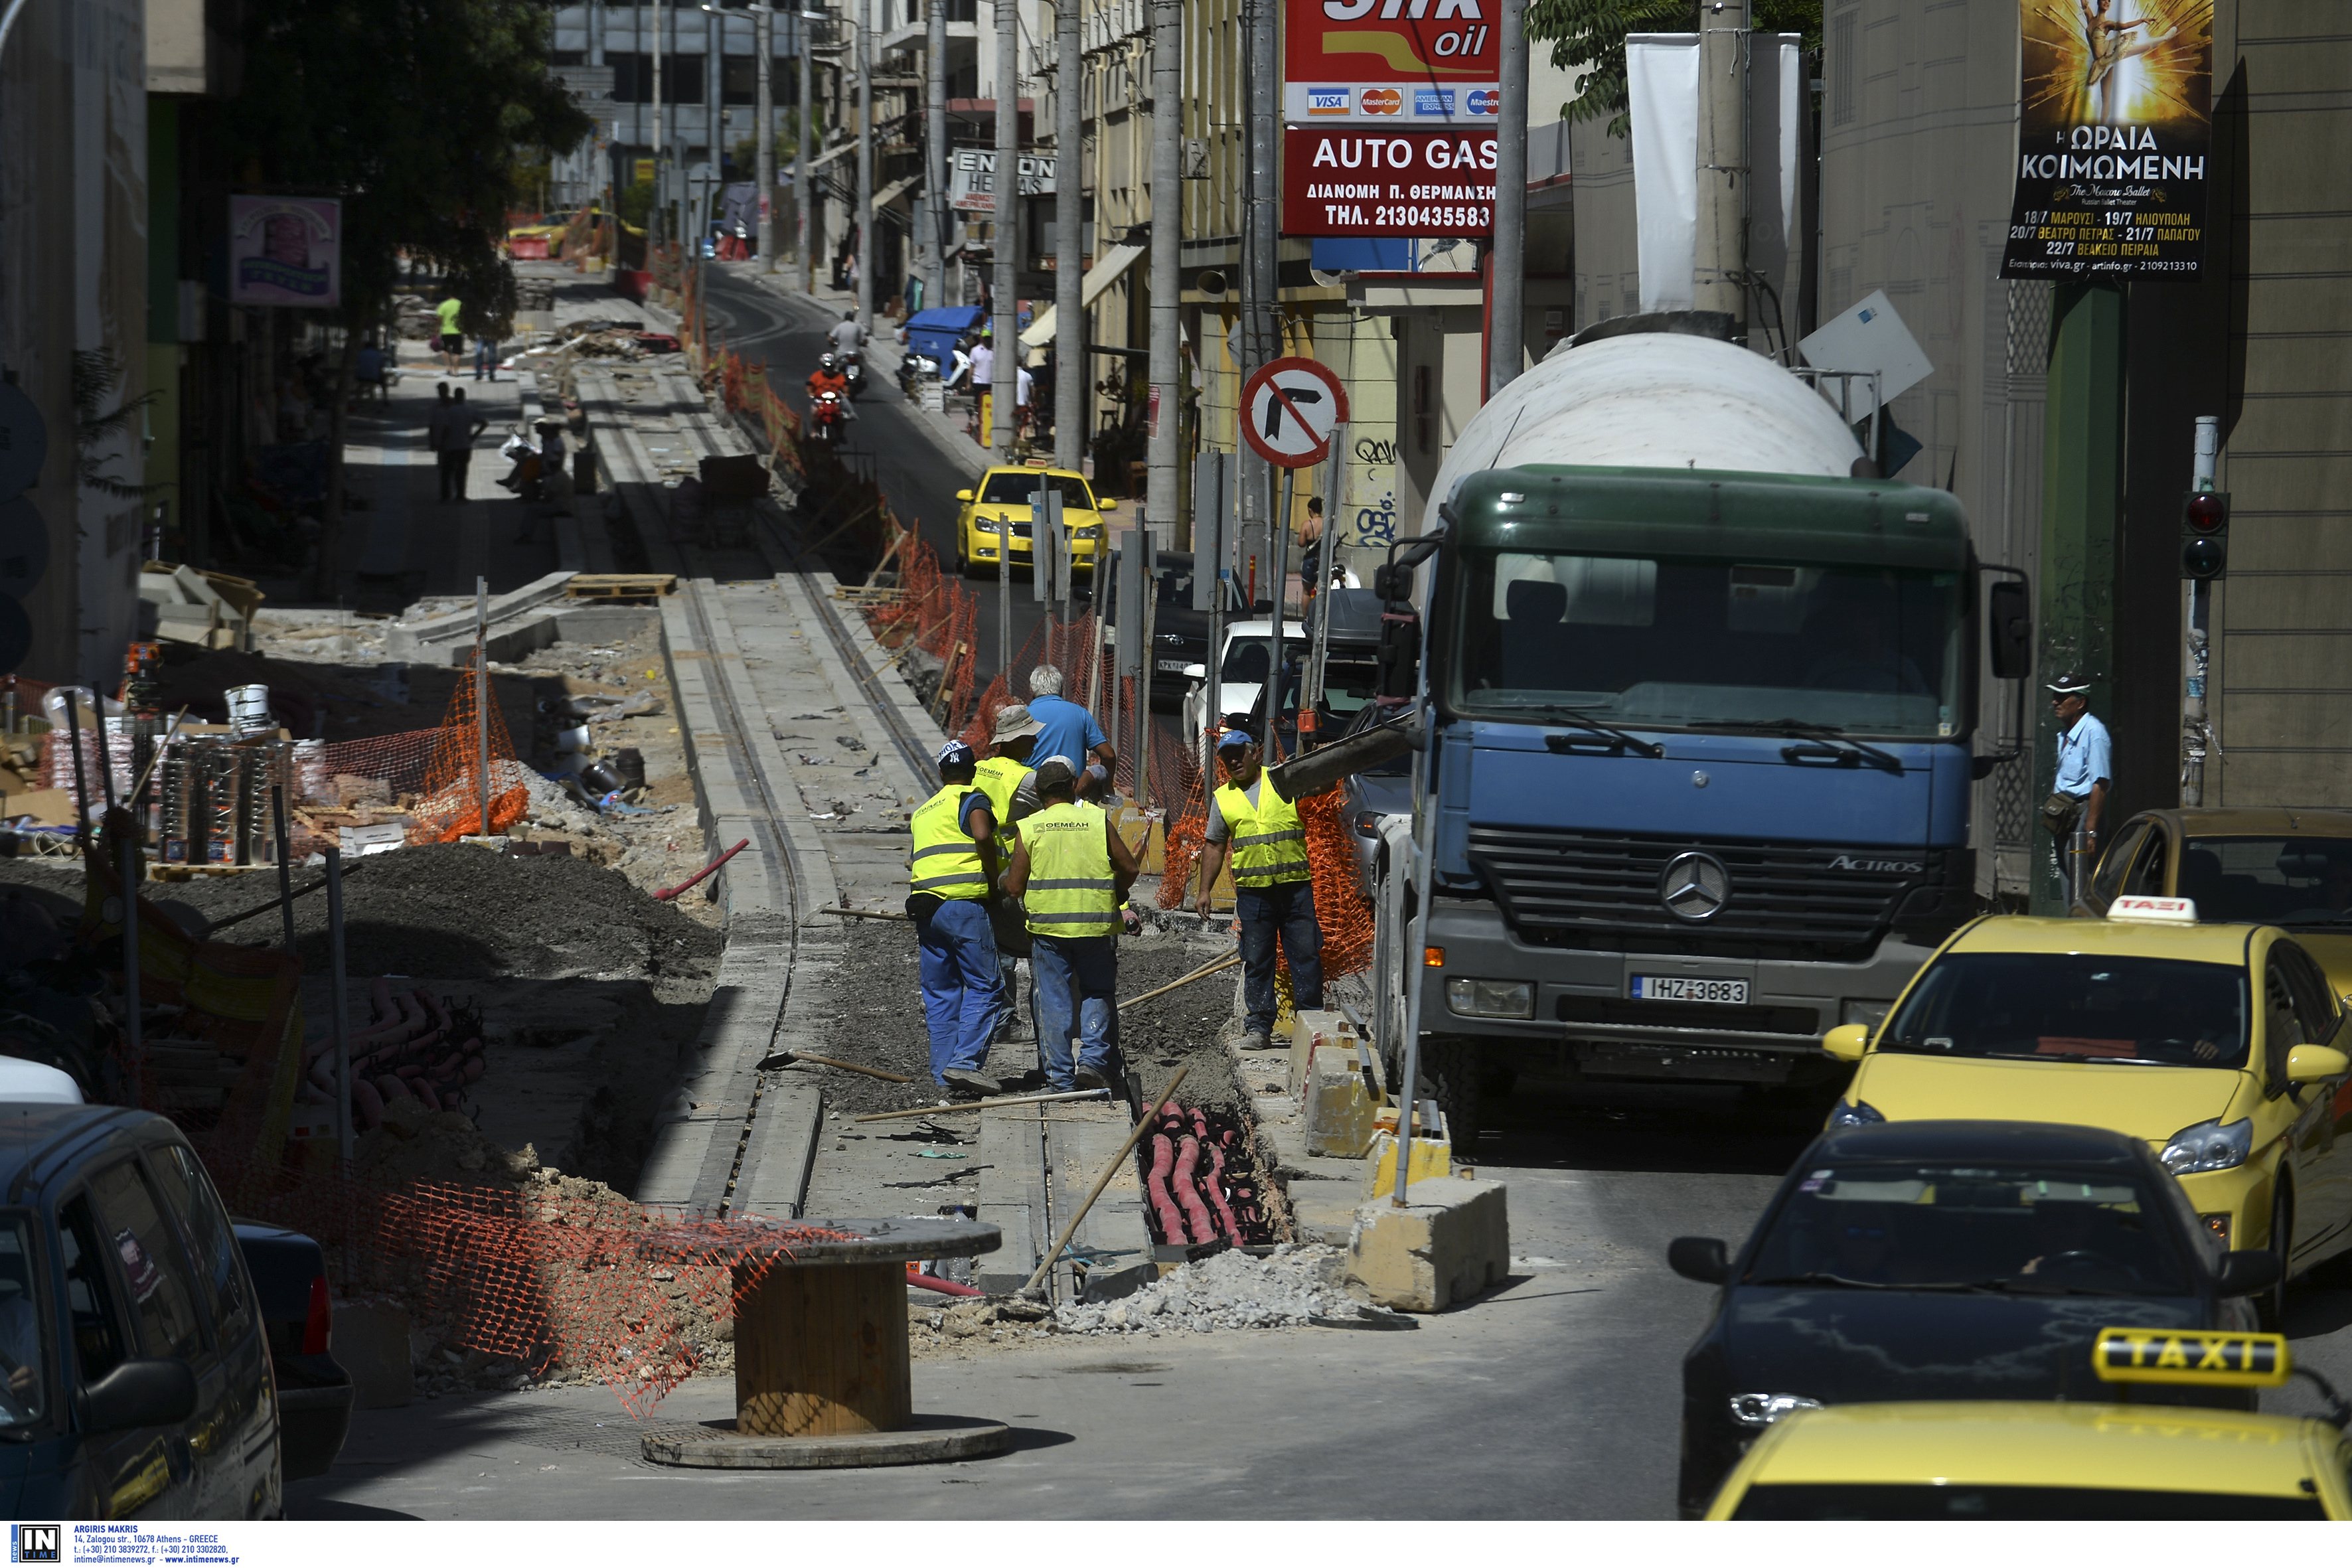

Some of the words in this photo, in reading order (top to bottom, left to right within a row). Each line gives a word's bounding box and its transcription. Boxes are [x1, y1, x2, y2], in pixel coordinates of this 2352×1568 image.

[1434, 24, 1489, 57] oil
[1314, 96, 1343, 108] VISA
[1362, 98, 1400, 107] MasterCard
[2056, 131, 2065, 143] Η
[2071, 125, 2157, 150] ΩΡΑΙΑ
[1312, 139, 1412, 169] AUTO
[1426, 139, 1498, 169] GAS
[958, 152, 1056, 178] ENON
[2021, 155, 2204, 179] ΚΟΙΜΩΜΕΝΗ
[970, 173, 1042, 195] HEAS
[1307, 184, 1379, 198] ΔΙΑΝΟΜΗ
[1389, 185, 1405, 199] Π.
[2071, 184, 2086, 196] The
[2122, 185, 2150, 196] Ballet
[1326, 205, 1369, 225] ΤΗΛ.
[1375, 206, 1490, 226] 2130435583
[2024, 210, 2047, 224] 18/7
[2051, 212, 2094, 225] ΜΑΡΟΥΣΙ
[2105, 212, 2132, 226] 19/7
[2136, 212, 2190, 226] ΗΛΙΟΥΠΟΛΗ
[2010, 226, 2036, 240] 20/7
[2038, 226, 2075, 240] ΘΕΑΤΡΟ
[2079, 227, 2114, 240] ΠΕΤΡΑΣ
[2126, 228, 2153, 241] 21/7
[2157, 228, 2200, 241] ΠΑΠΑΓΟΥ
[2047, 242, 2074, 256] 22/7
[2077, 242, 2118, 256] ΒΕΑΚΕΙΟ
[2121, 243, 2159, 256] ΠΕΙΡΑΙΑ
[2051, 260, 2085, 272] viva.gr
[2092, 262, 2132, 272] artinfo.gr
[2140, 262, 2197, 271] 2109213310
[2120, 900, 2185, 911] ΤΑΞΙ
[2124, 1336, 2254, 1371] TAXI
